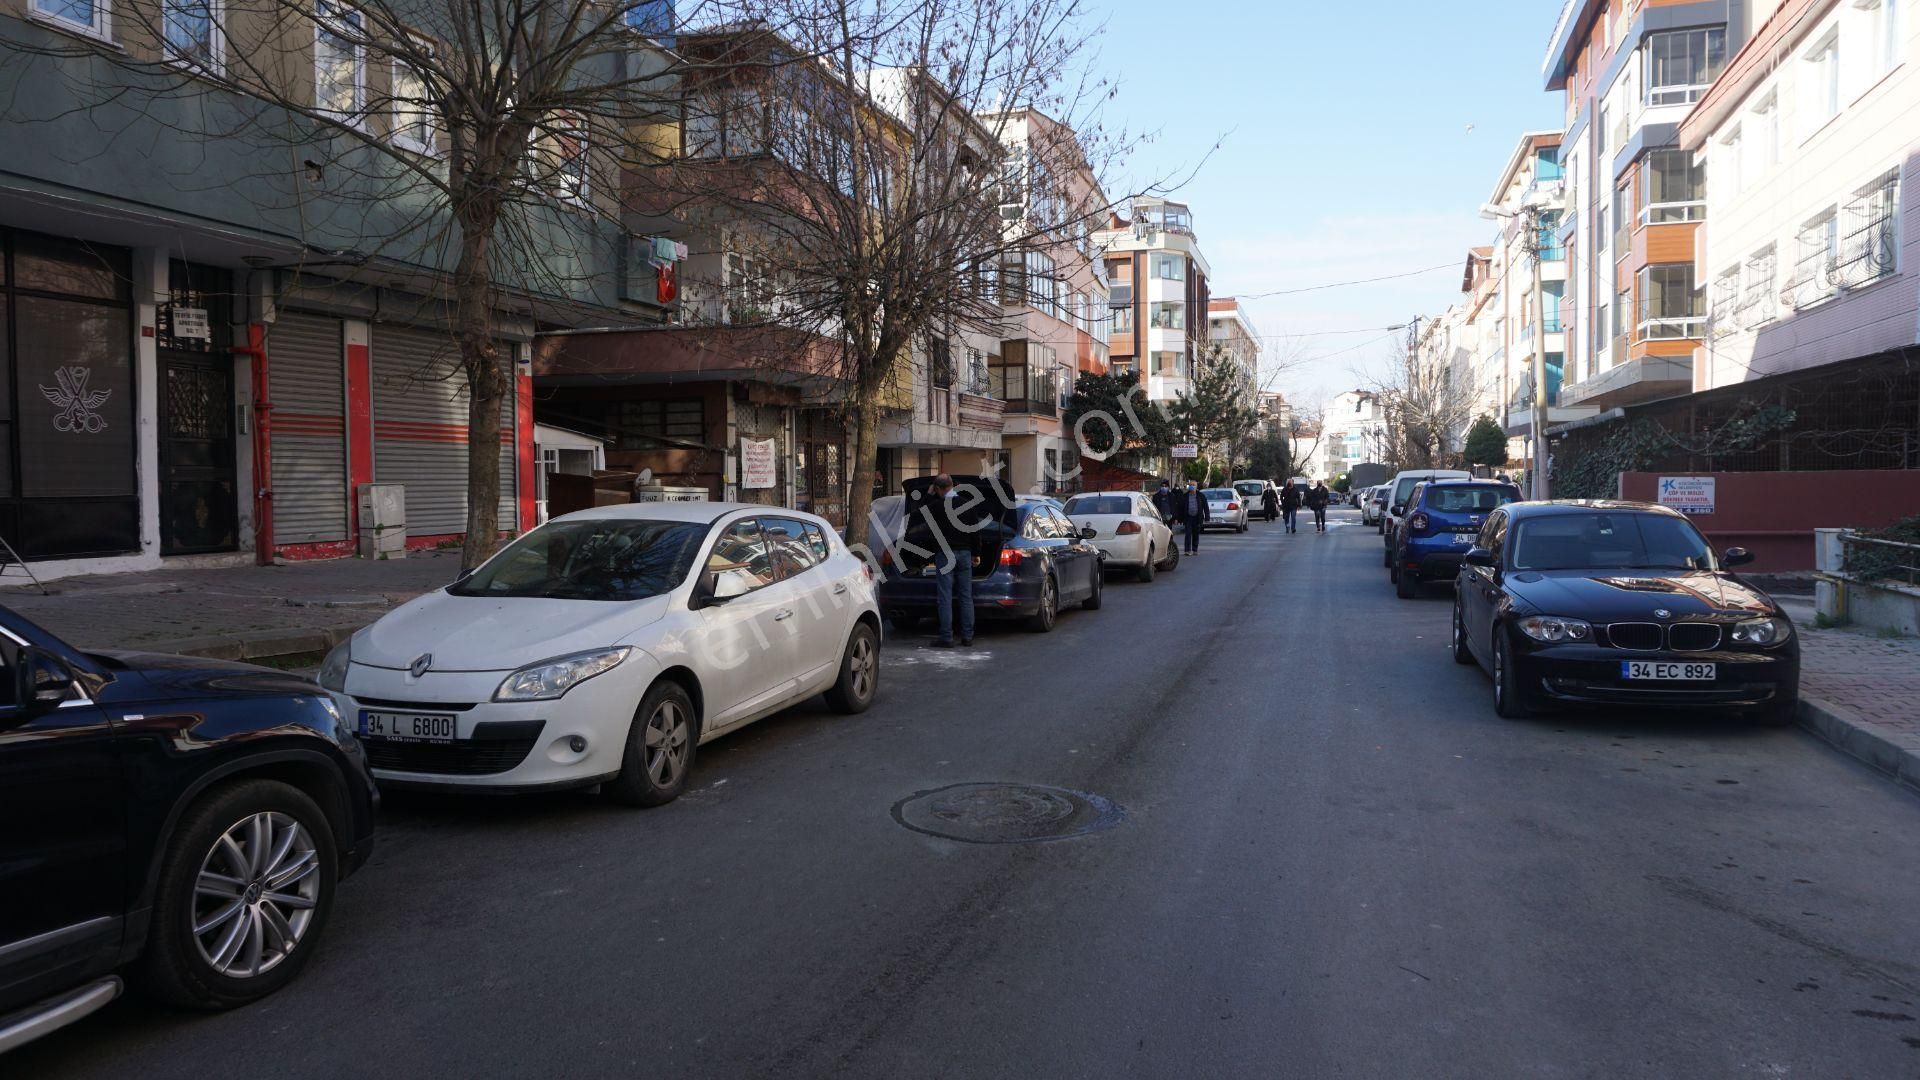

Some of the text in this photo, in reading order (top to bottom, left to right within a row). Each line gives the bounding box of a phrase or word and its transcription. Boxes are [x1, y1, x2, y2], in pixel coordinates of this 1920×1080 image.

[1631, 663, 1713, 679] 34 EC 892
[368, 714, 450, 737] 34 L 6800
